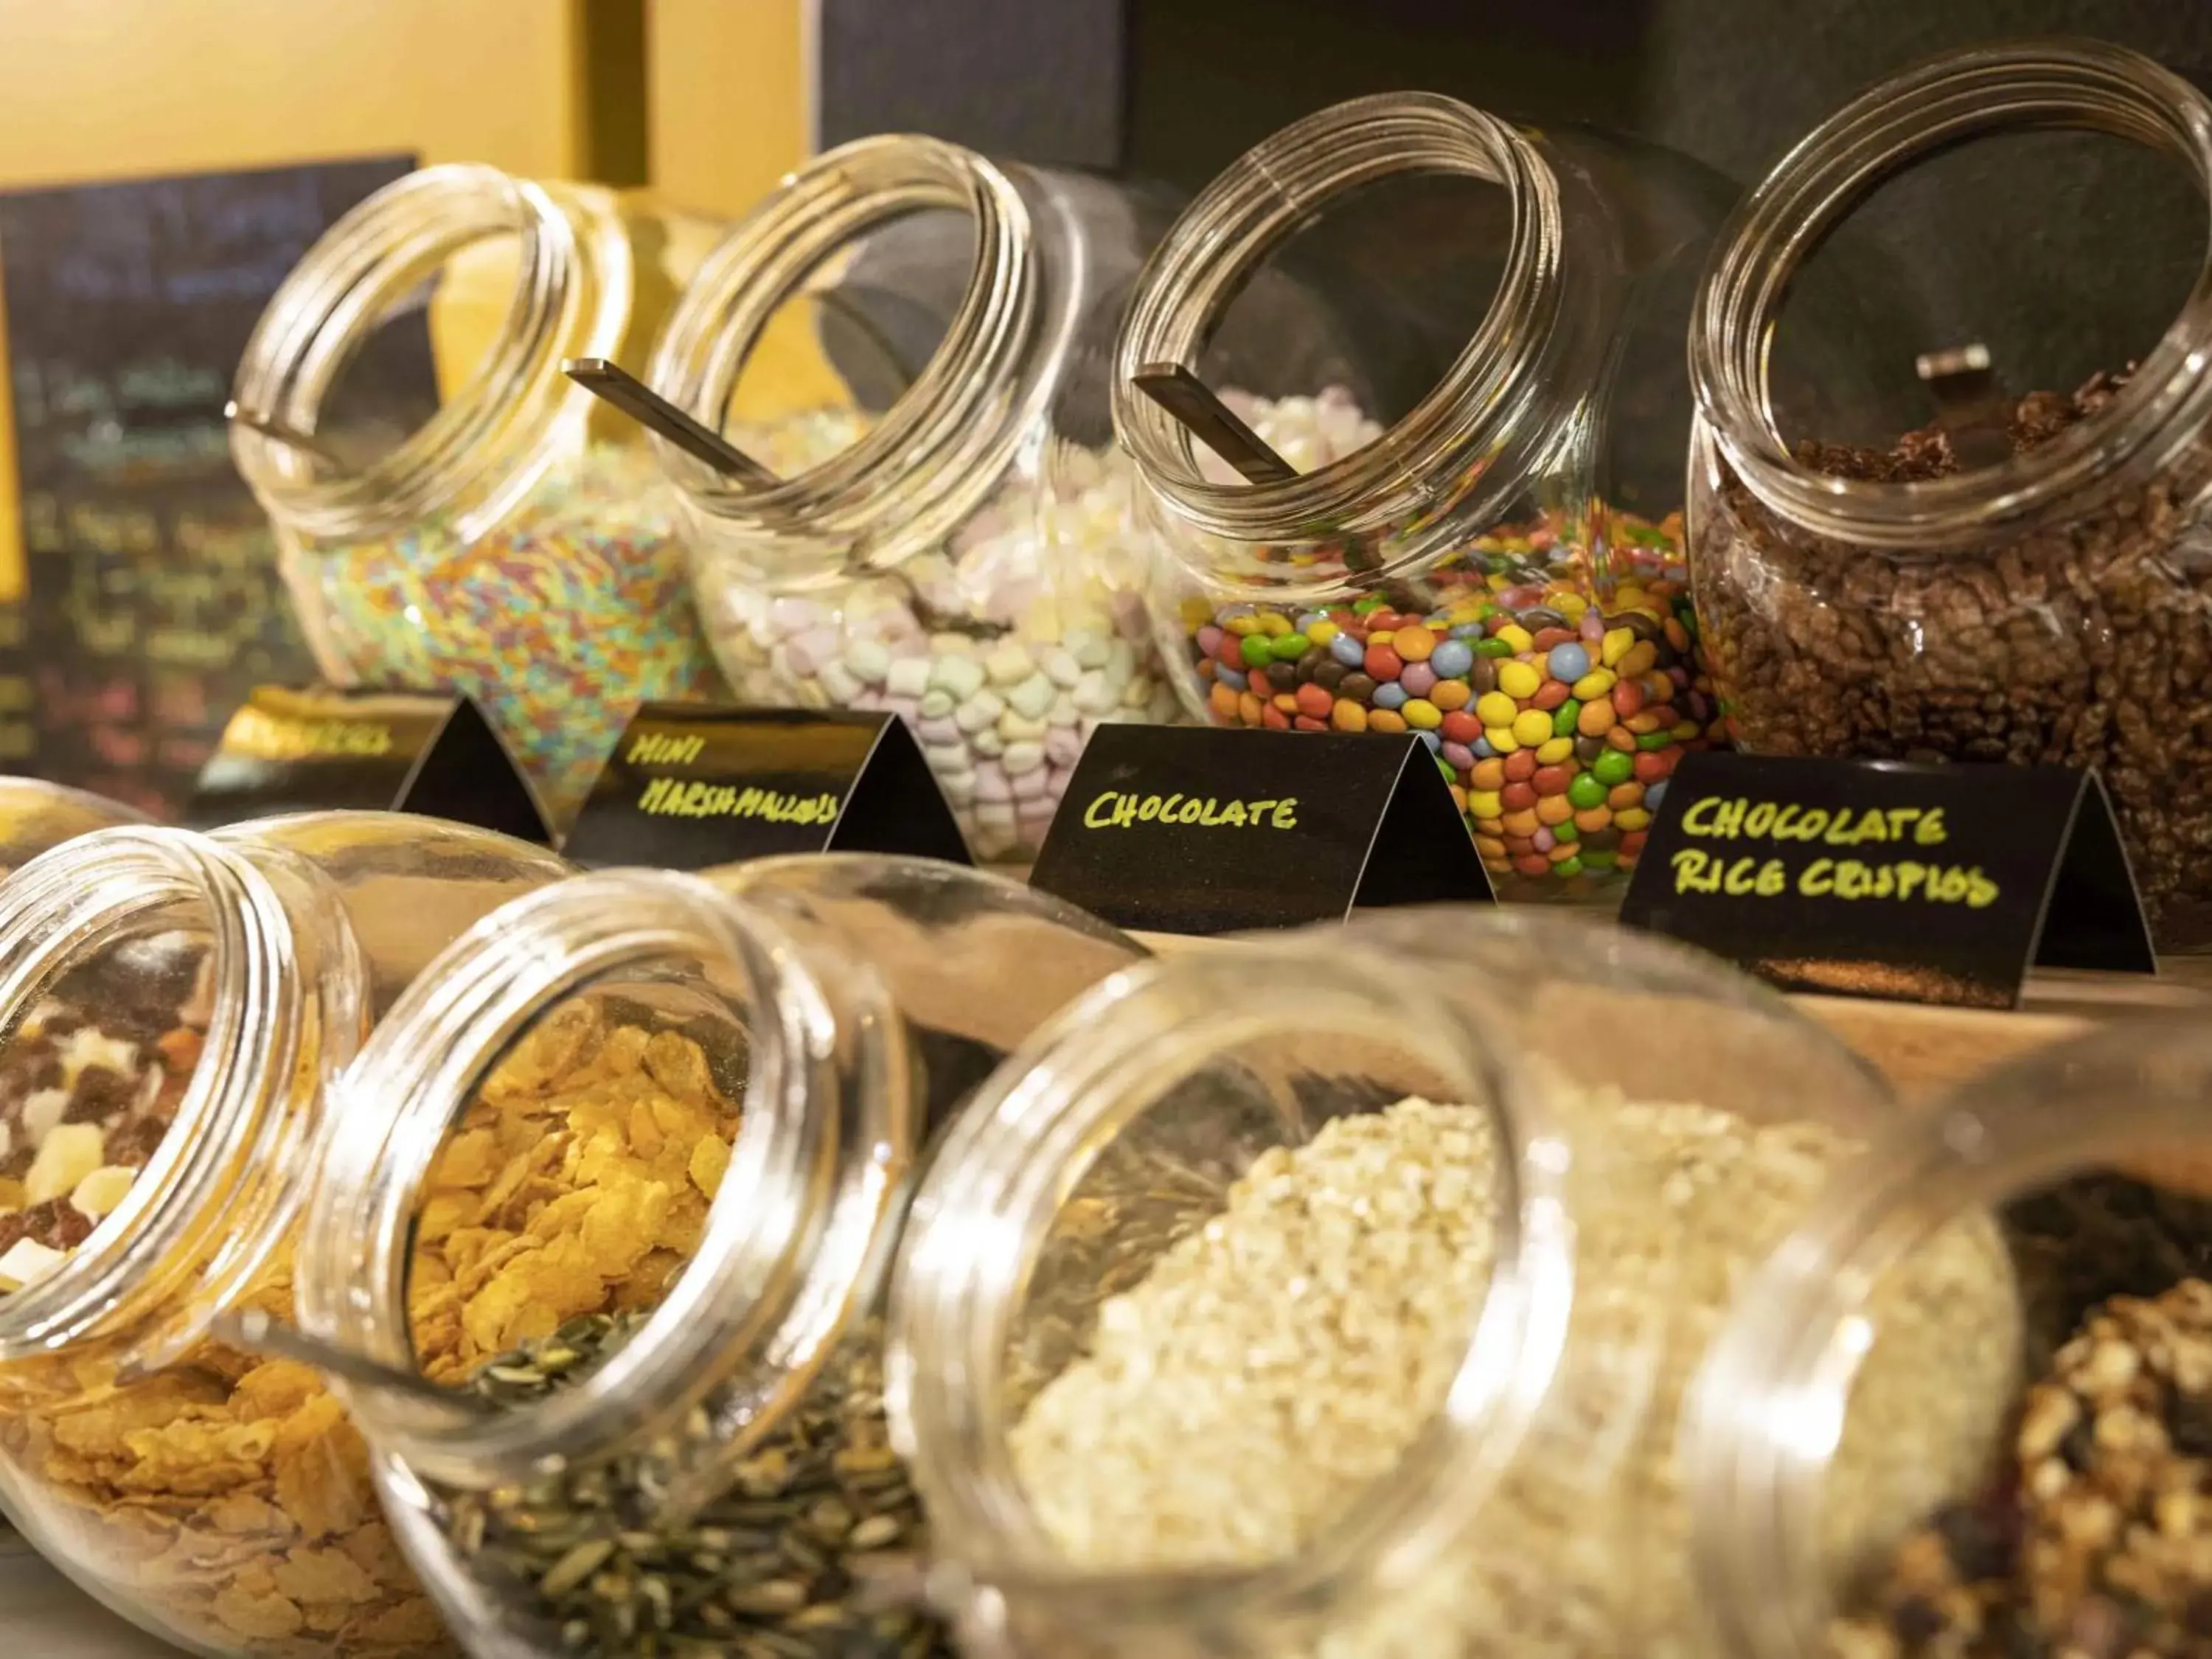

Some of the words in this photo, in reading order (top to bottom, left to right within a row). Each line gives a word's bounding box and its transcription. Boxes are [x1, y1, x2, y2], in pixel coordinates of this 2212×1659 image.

[626, 732, 706, 765] MINI
[1084, 790, 1298, 830] CHOCOLATE
[1682, 796, 1947, 844] CHOCOLATE
[1671, 848, 1785, 896] RICE
